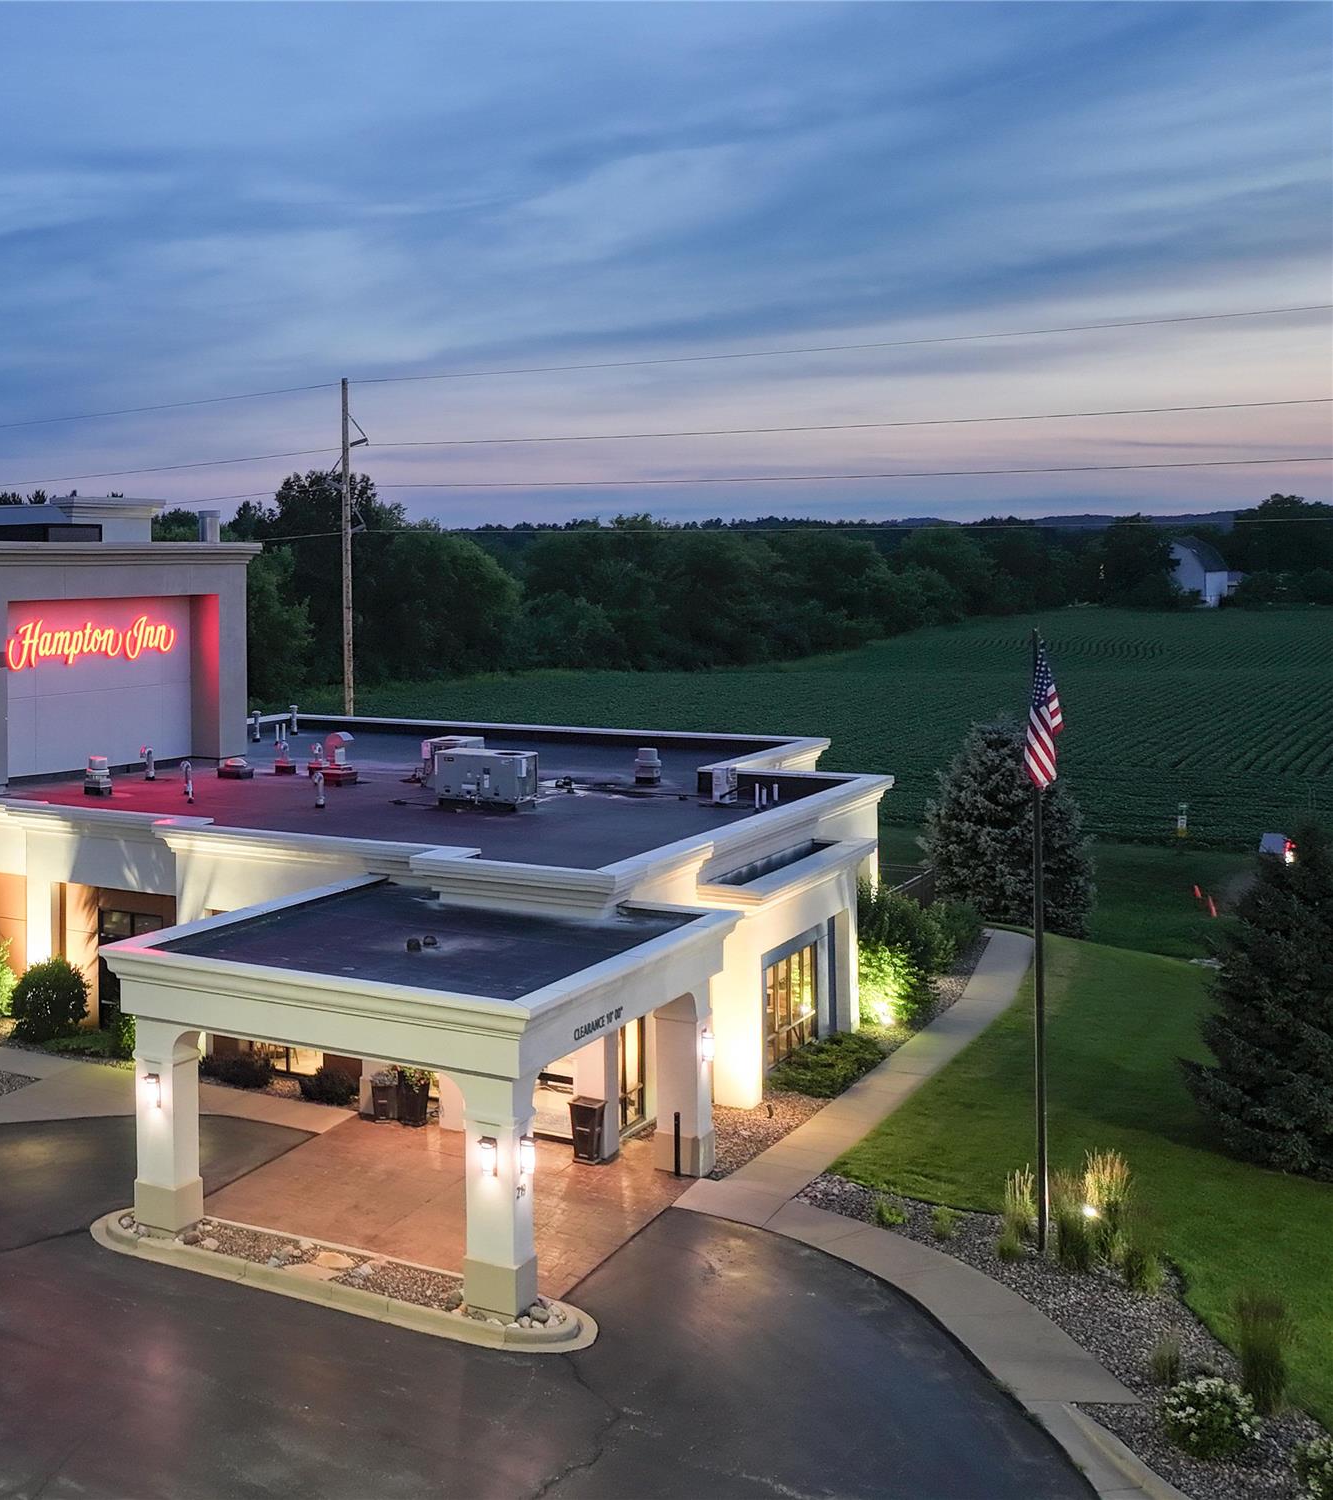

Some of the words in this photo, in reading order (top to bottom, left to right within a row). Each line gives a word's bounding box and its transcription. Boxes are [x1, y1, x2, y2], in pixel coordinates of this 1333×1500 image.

[7, 618, 123, 671] Hampton
[125, 615, 175, 660] Inn
[573, 1014, 605, 1041] CLEARANCE
